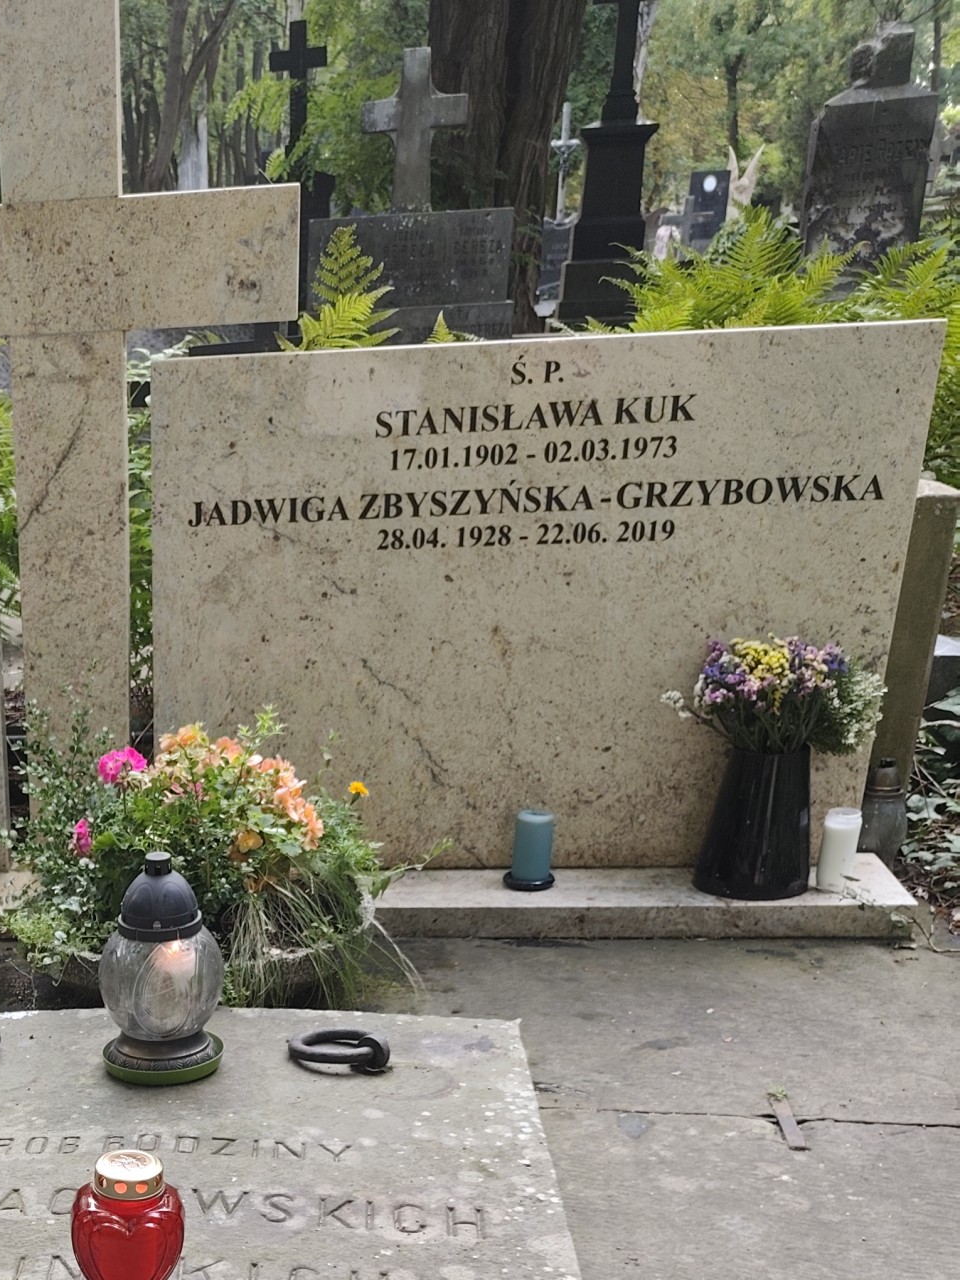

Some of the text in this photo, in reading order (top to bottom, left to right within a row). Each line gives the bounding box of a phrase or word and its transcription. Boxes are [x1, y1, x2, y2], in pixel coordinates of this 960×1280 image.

[374, 393, 698, 439] STANISŁAWA KUK
[389, 443, 519, 472] 17.01.1902
[543, 435, 679, 464] 02.03.1973
[187, 474, 886, 528] JADWIGA ZBYSZYŃSKA-GRZYBOWSKA
[376, 526, 447, 552] 28.04.
[455, 523, 512, 549] 1928
[536, 520, 610, 546] 22.06.
[616, 516, 676, 544] 2019
[103, 1133, 353, 1163] RODZINY
